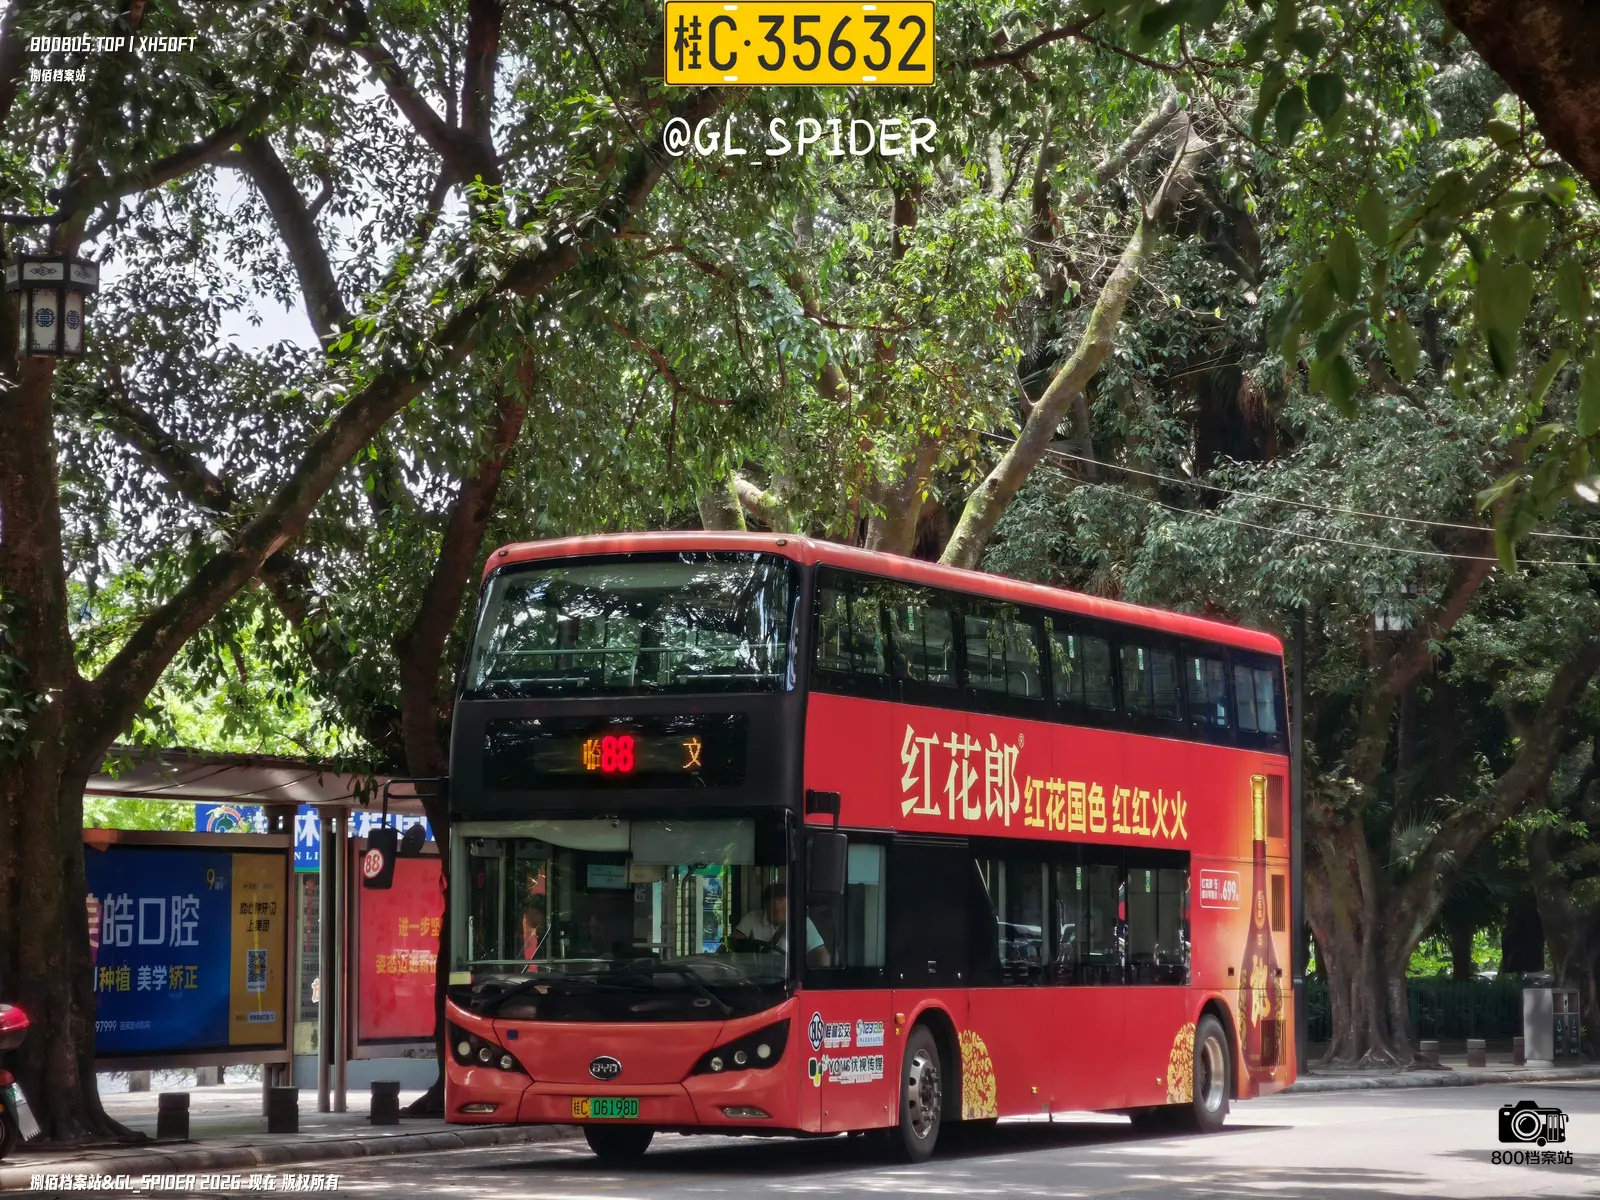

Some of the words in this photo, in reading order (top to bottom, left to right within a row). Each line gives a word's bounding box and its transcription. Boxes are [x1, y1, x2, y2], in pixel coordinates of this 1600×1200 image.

[601, 735, 633, 772] 88
[683, 737, 701, 769] 文
[901, 724, 1020, 827] 红花郎
[1023, 775, 1108, 834] 红花国色
[1112, 784, 1188, 840] 红红火火
[364, 854, 381, 874] 88
[137, 965, 198, 992] 美学矫正
[592, 1063, 618, 1073] BYD
